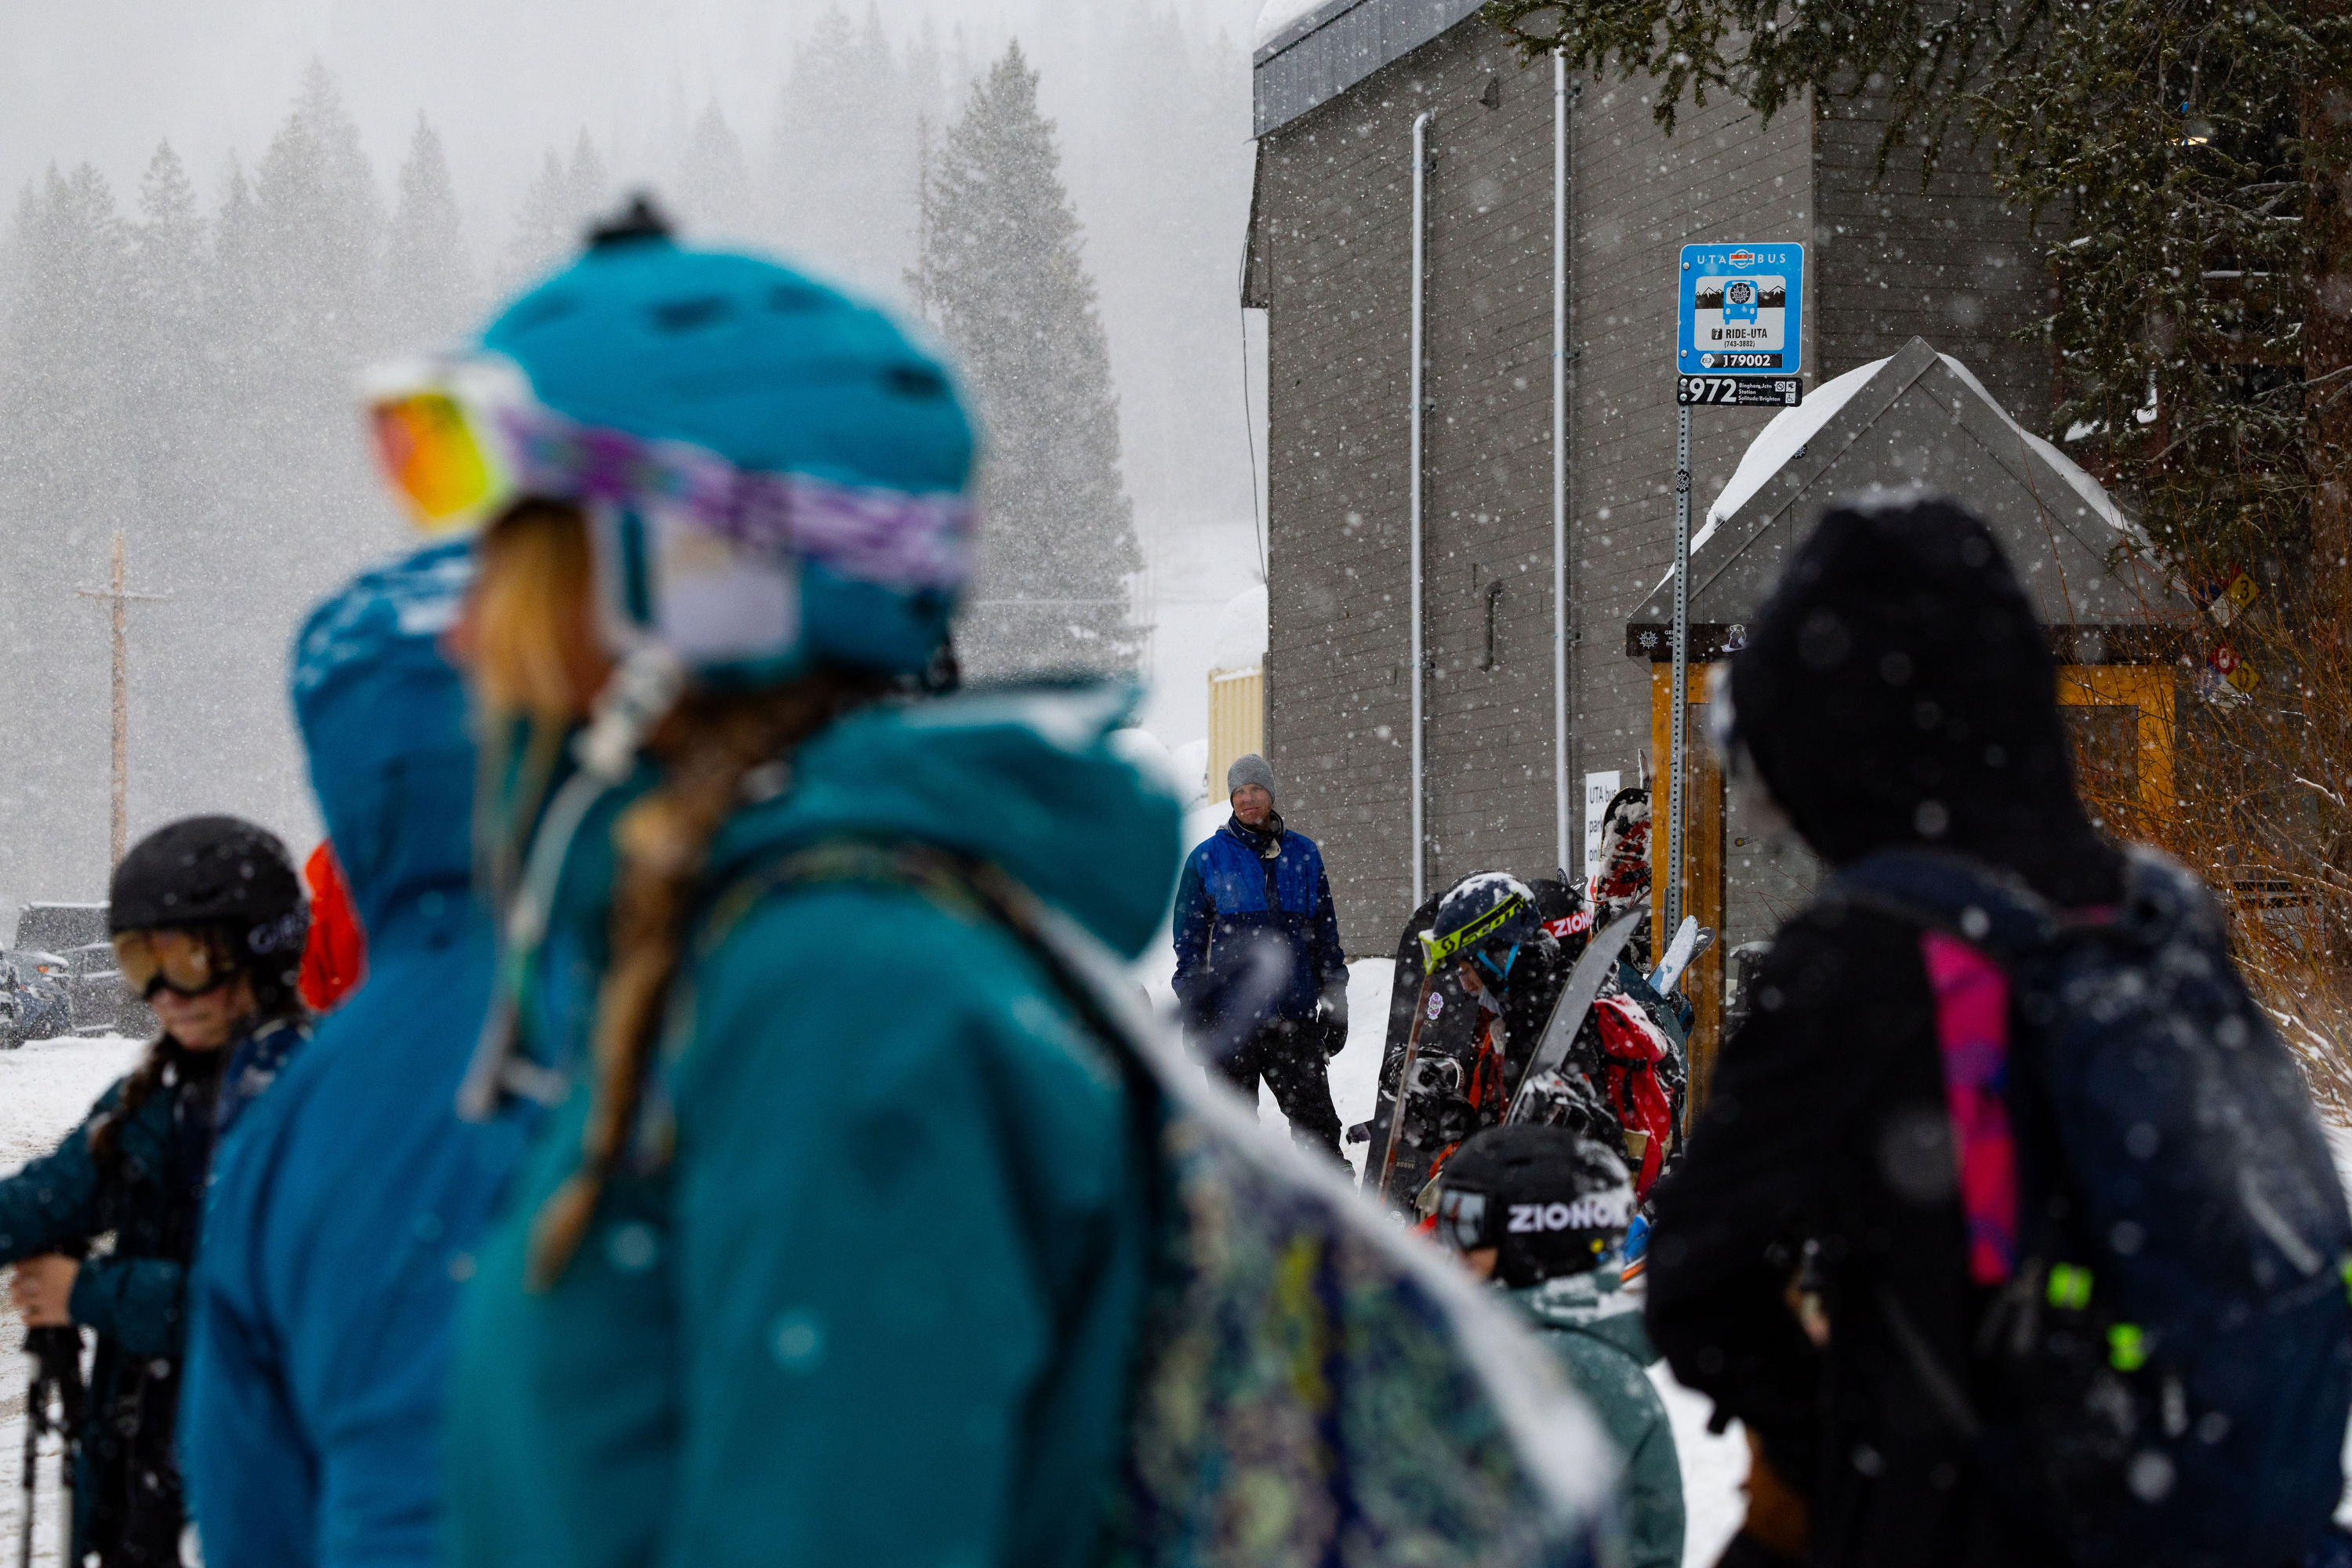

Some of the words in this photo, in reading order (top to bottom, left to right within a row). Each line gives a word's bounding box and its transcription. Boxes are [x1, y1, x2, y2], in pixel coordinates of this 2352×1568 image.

[1697, 255, 1726, 264] UTA
[1758, 253, 1786, 263] BUS
[1726, 328, 1768, 339] RIDE-UTA
[1723, 354, 1771, 366] 179002
[1689, 377, 1737, 403] 972
[2240, 580, 2249, 600] 3
[1589, 786, 1604, 804] UTA
[1589, 844, 1600, 862] onl
